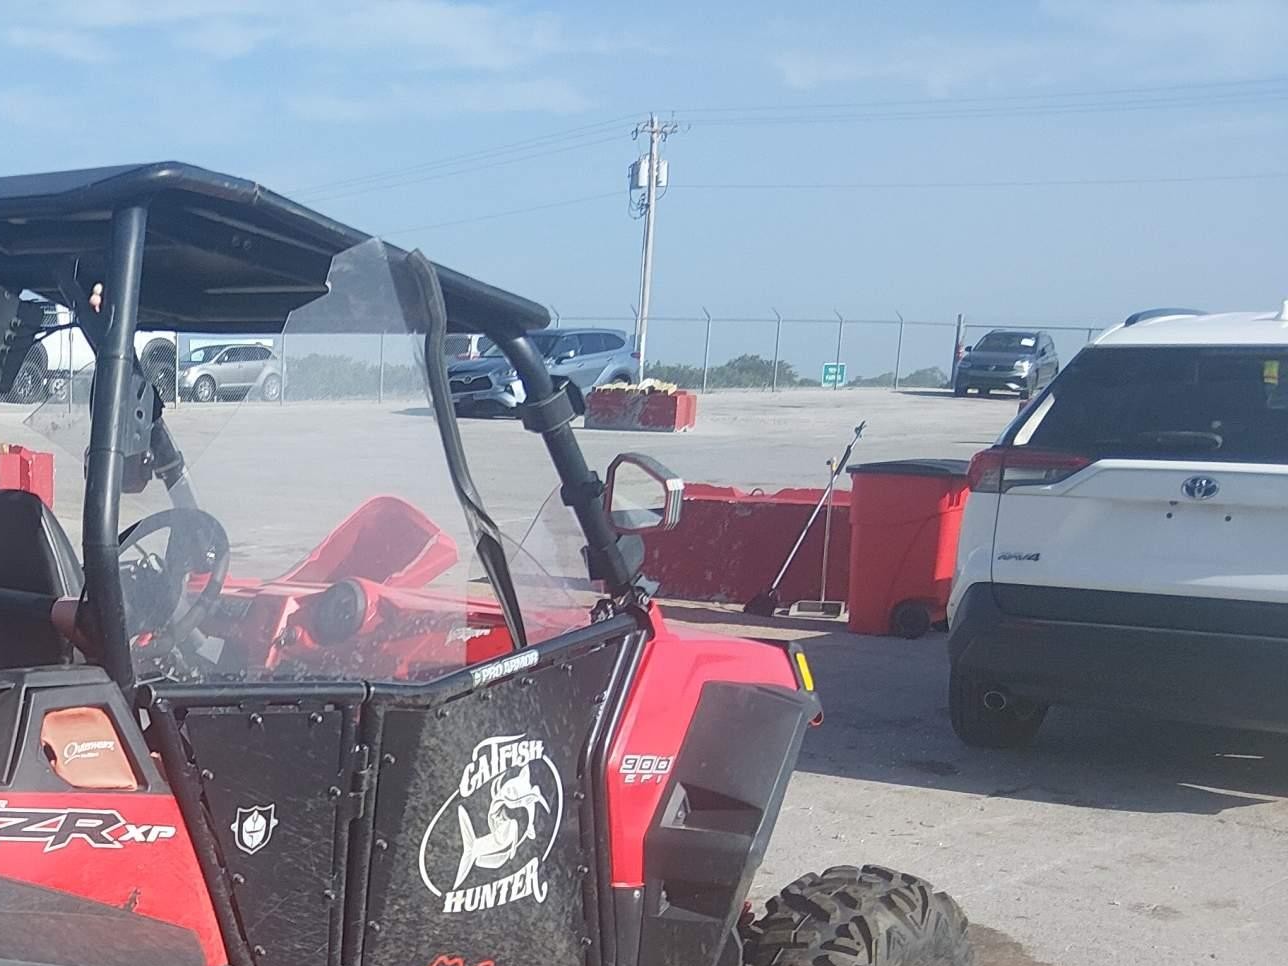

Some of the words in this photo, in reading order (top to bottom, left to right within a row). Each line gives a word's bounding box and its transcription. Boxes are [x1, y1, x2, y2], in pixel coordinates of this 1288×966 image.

[481, 663, 504, 683] PRO
[503, 652, 540, 677] ARMOR
[620, 754, 674, 774] 900
[623, 774, 664, 784] EFI
[119, 824, 177, 843] XP
[442, 857, 548, 912] HUNTER
